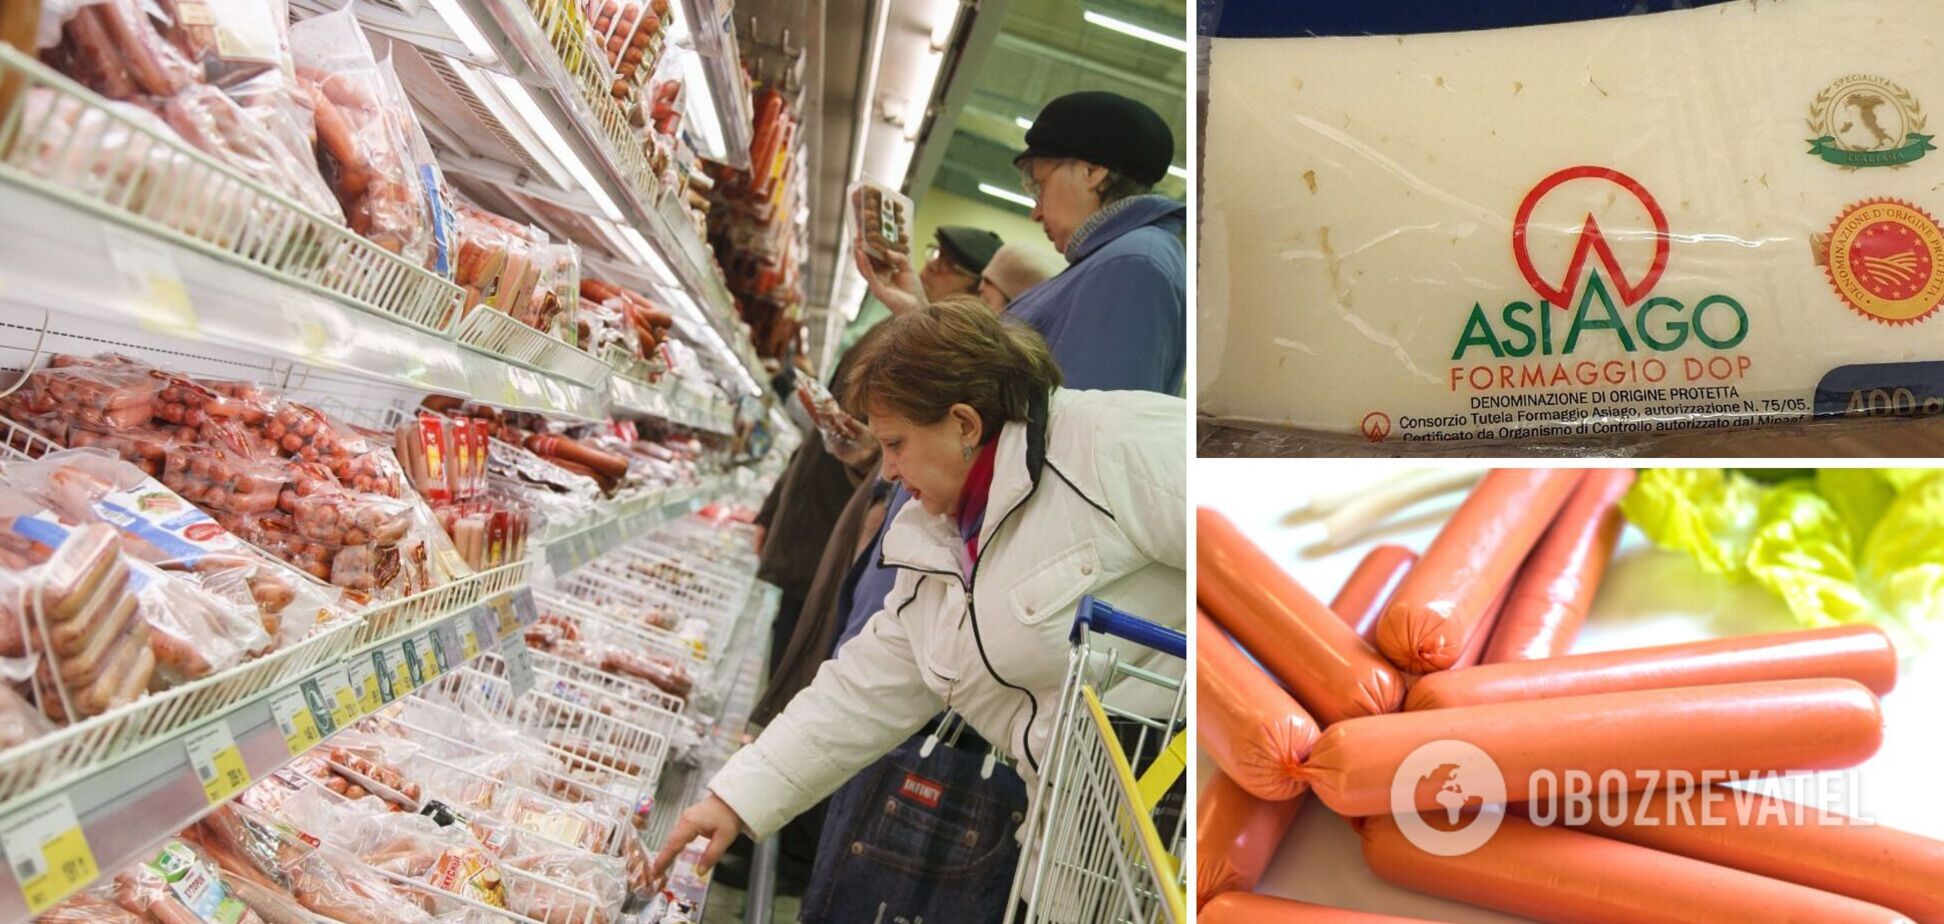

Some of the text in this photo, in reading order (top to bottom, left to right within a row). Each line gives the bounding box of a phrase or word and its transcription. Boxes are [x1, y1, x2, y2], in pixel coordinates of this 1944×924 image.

[1835, 211, 1871, 301] DENOMINAZIONE
[1872, 208, 1935, 238] D'ORIGINE
[1451, 267, 1749, 360] ASIAGO
[1451, 355, 1751, 391] FORMAGGIO DOP
[1400, 398, 1811, 429] Consorzio Tutela Formaggio Asiago, autorizzazione N. 75/05.
[1471, 385, 1740, 409] DENOMINAZIONE DI ORIGINE PROTETTA
[1477, 428, 1495, 440] da
[1499, 423, 1573, 439] Organismo
[1576, 422, 1589, 435] di
[1592, 418, 1656, 434] Controllo
[1656, 417, 1730, 431] autorizzato
